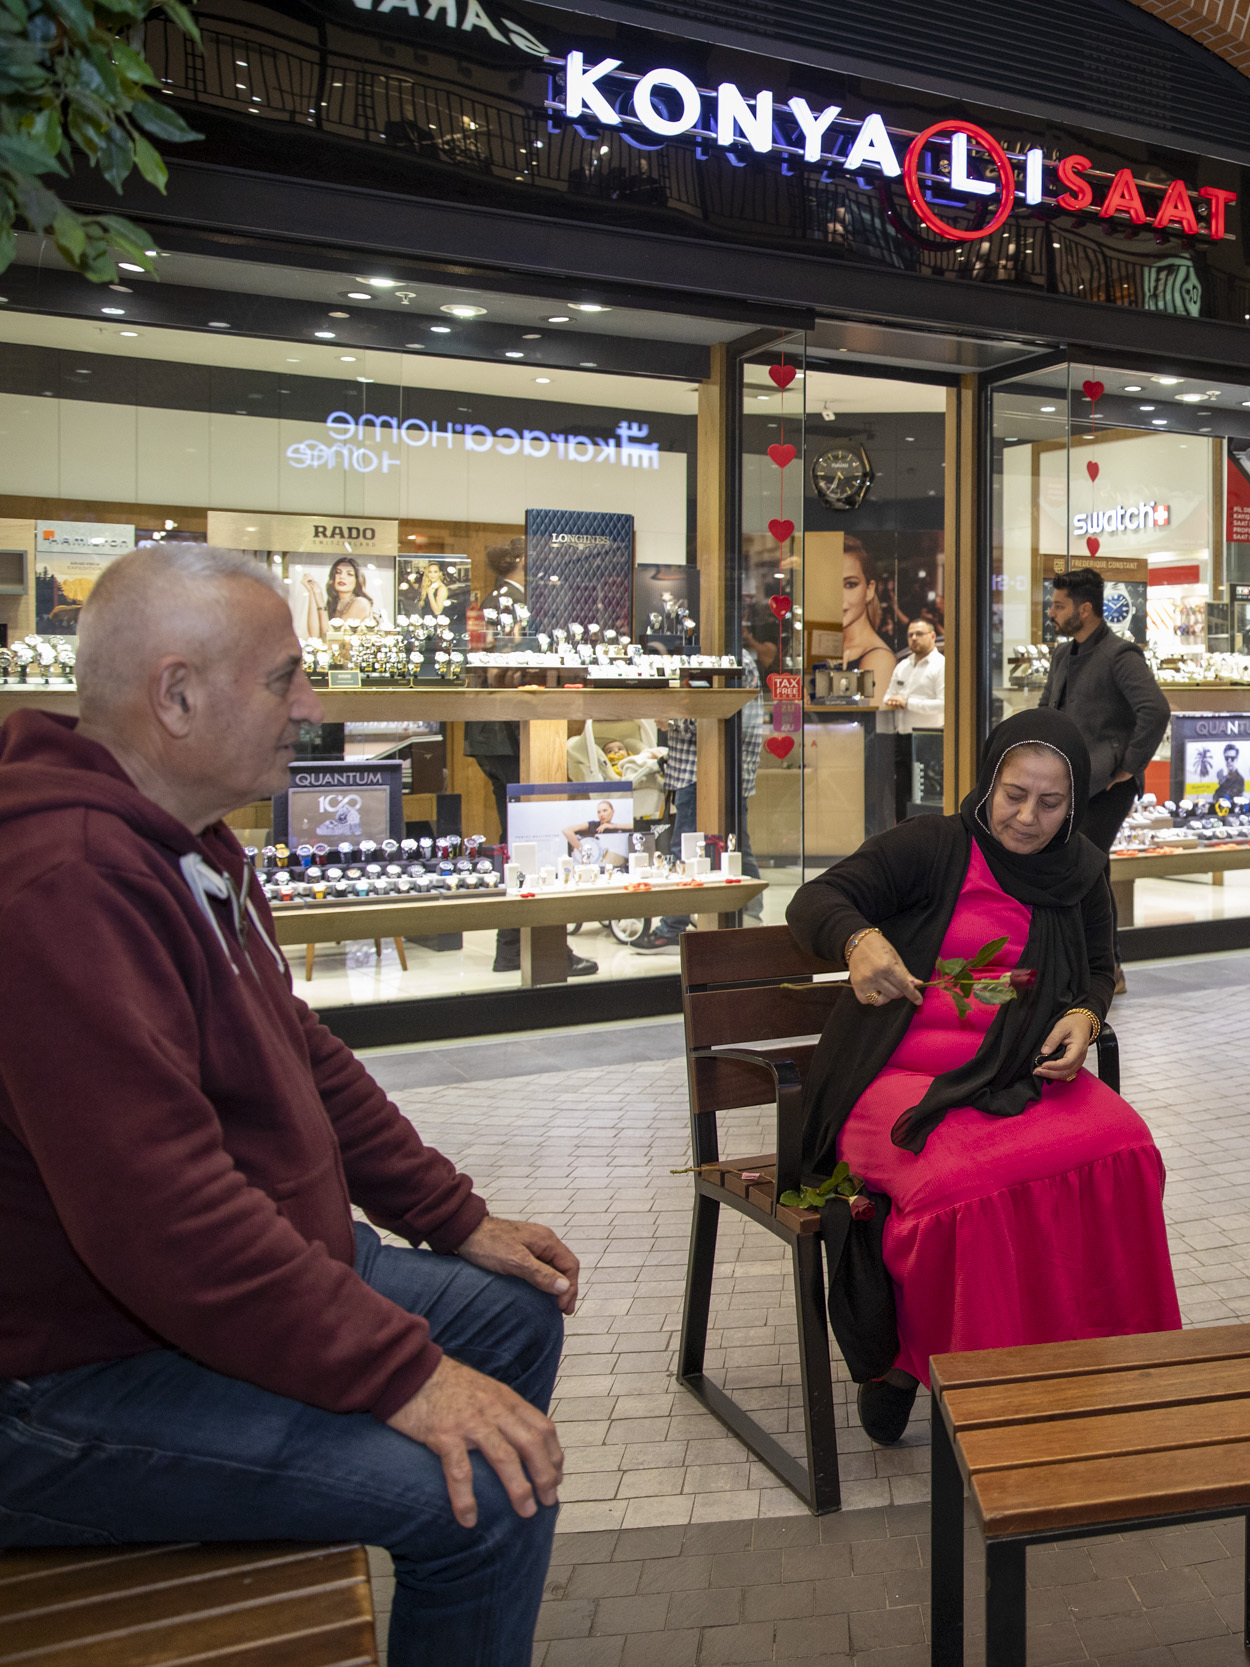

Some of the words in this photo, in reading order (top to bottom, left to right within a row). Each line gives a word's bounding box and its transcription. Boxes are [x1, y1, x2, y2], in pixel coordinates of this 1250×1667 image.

[1057, 154, 1237, 240] SAAT
[1073, 501, 1155, 536] swatch
[313, 525, 376, 540] RADO
[552, 533, 610, 545] LONGINES
[1071, 560, 1108, 569] FREDERIQUE
[1108, 561, 1138, 570] CONSTANT
[774, 678, 799, 688] TAX
[776, 687, 799, 695] FREE
[295, 772, 382, 786] QUANTUM
